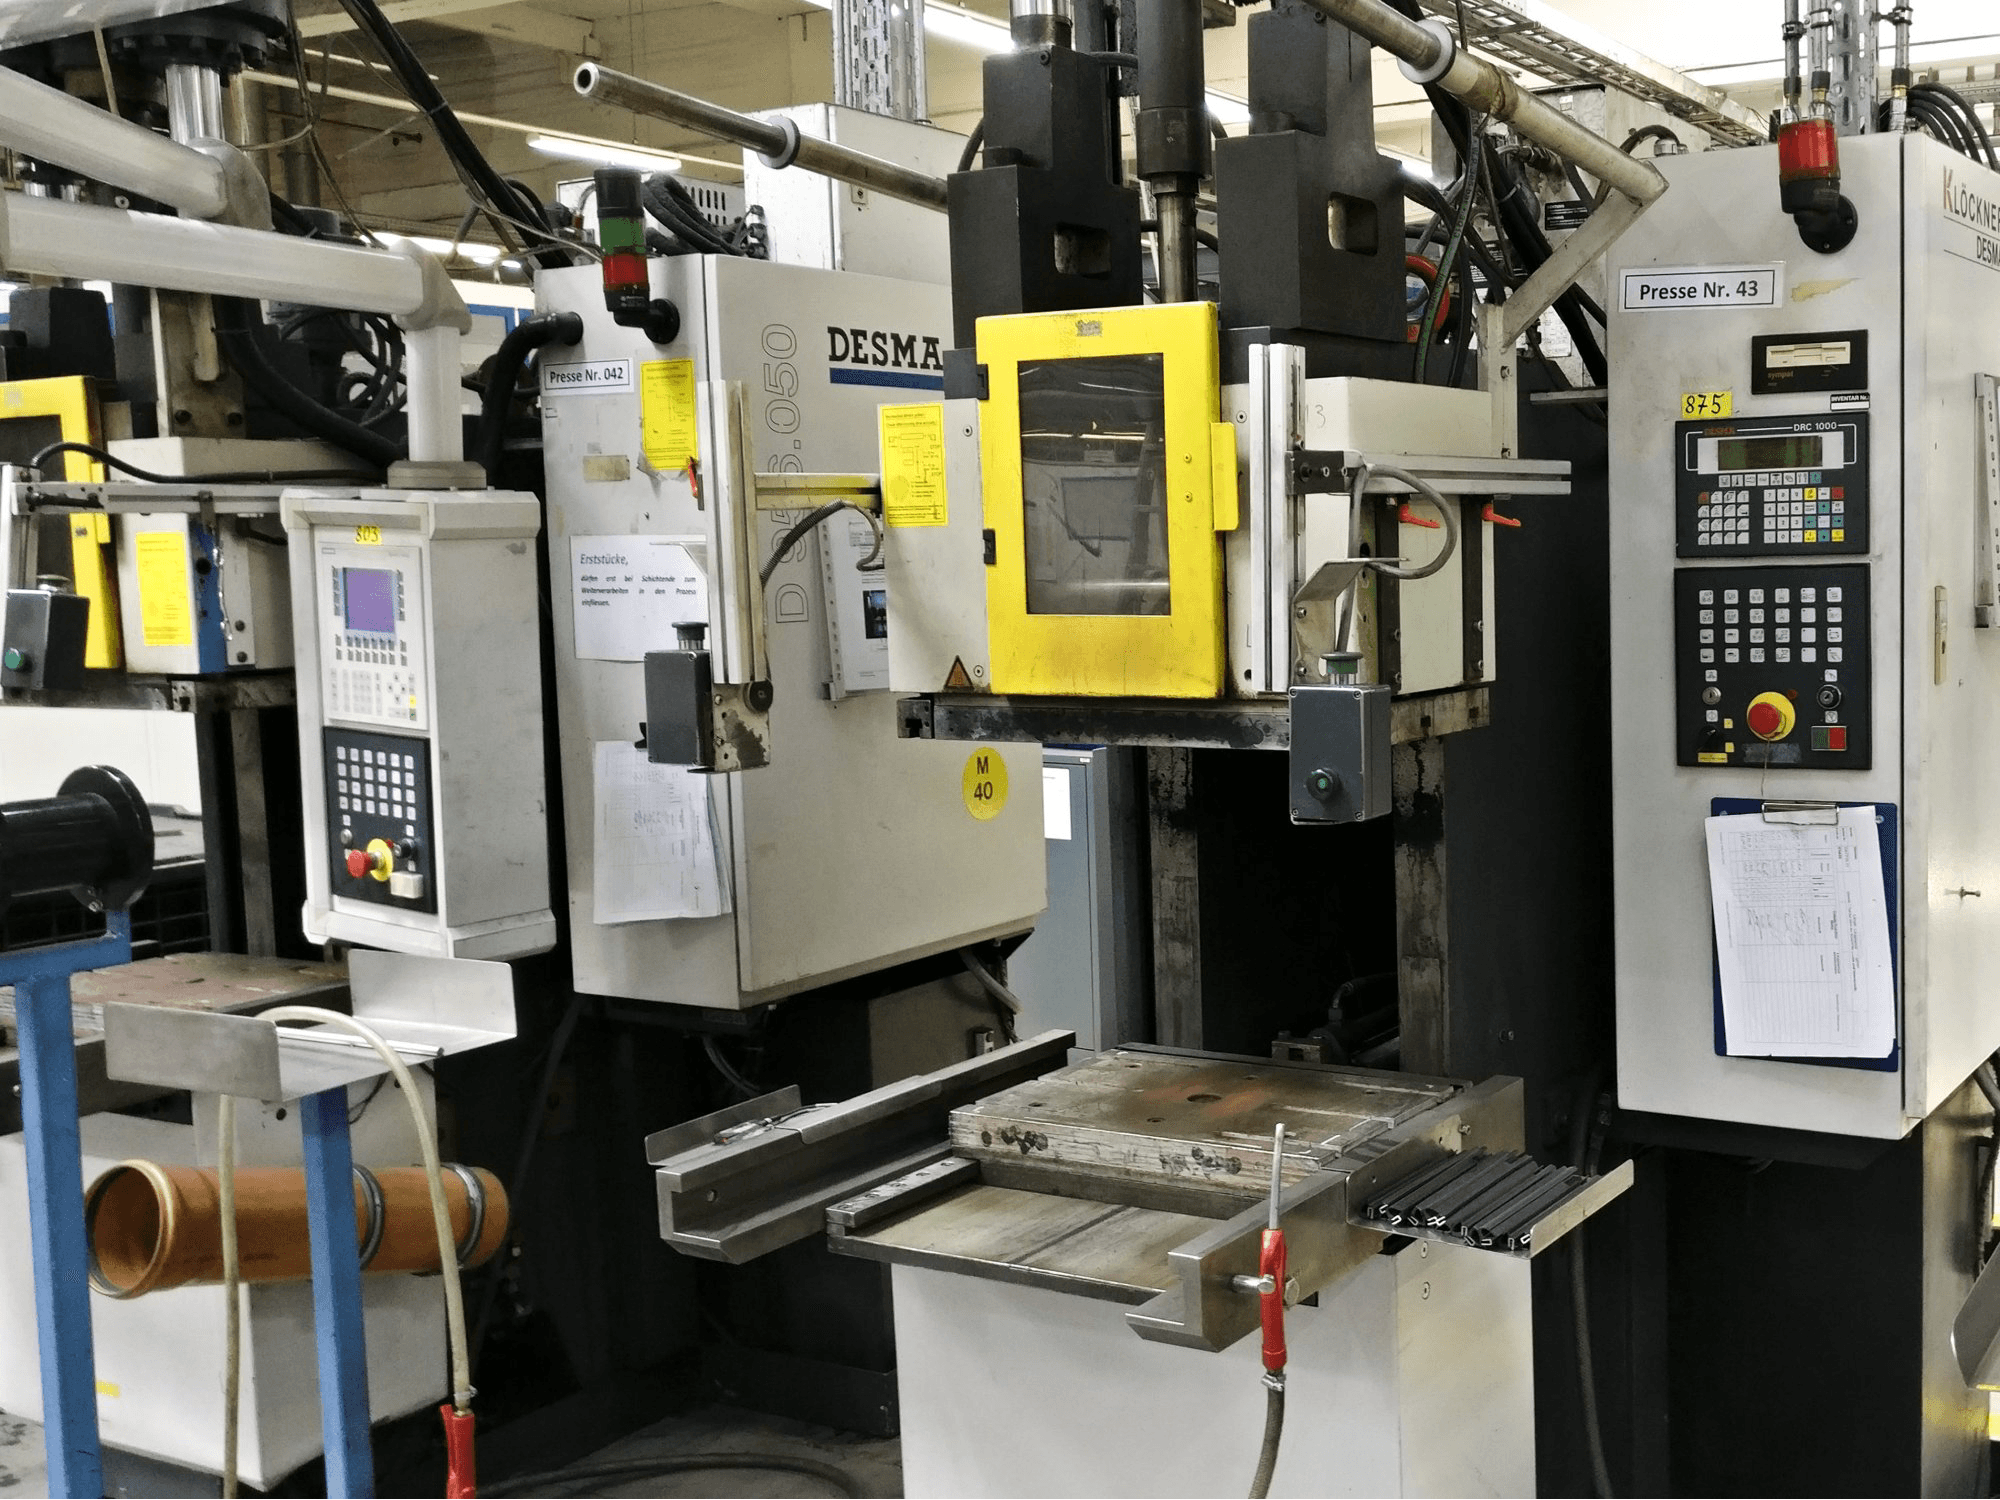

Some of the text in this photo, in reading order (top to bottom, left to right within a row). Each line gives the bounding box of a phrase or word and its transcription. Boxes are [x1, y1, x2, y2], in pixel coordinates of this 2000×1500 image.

[1977, 235, 2000, 267] DESM
[1639, 279, 1759, 300] Presse Nr. 43
[827, 326, 943, 371] DESMA
[550, 367, 624, 383] Presse Nr. 042
[1685, 393, 1725, 414] 875
[1793, 421, 1837, 431] DRC 1000
[580, 553, 629, 566] Erststücke,
[774, 583, 809, 623] D
[976, 755, 989, 775] M
[973, 781, 993, 801] 40
